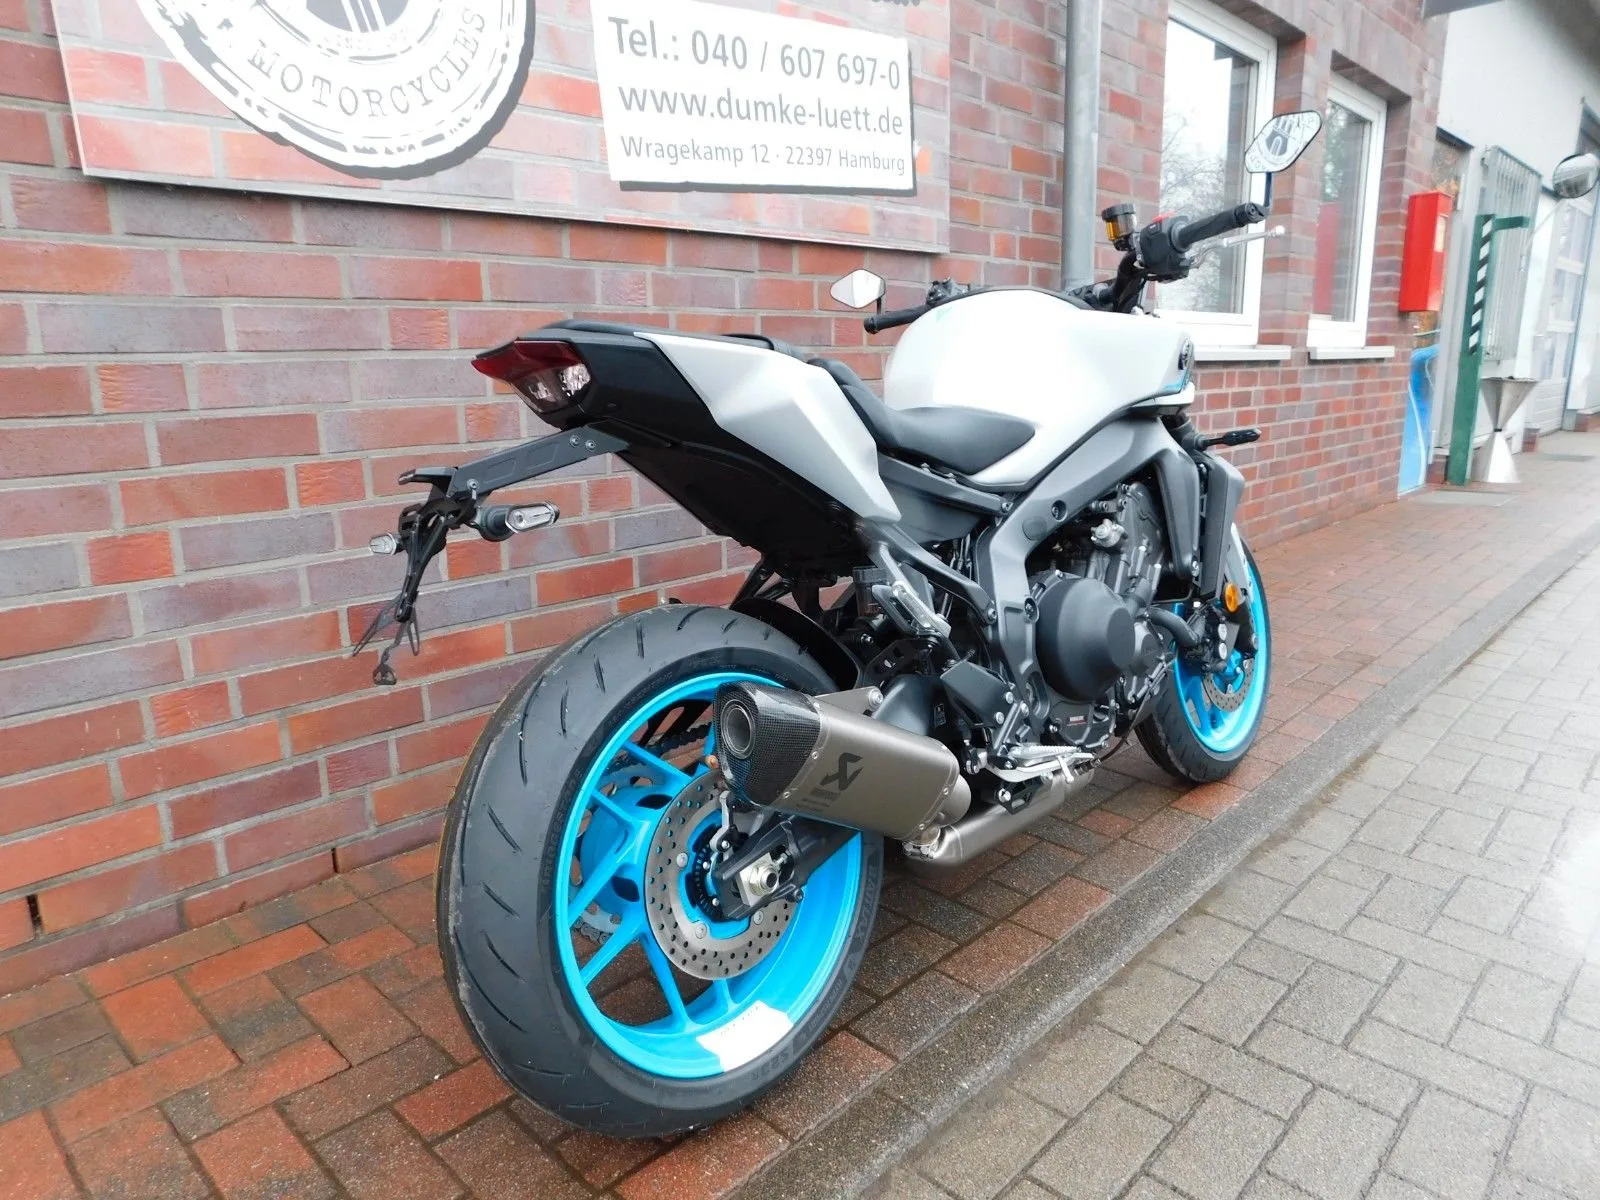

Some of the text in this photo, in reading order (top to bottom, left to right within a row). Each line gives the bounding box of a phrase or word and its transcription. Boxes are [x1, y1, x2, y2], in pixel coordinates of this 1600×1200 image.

[247, 7, 485, 117] MOTORCYCLES
[607, 16, 900, 90] Tel.: 040 / 607 697-0
[618, 86, 903, 135] www.dumke-luett.de
[620, 135, 744, 167] Wragekamp
[751, 144, 770, 164] 12
[785, 145, 832, 166] 22397
[838, 150, 905, 176] Hamburg
